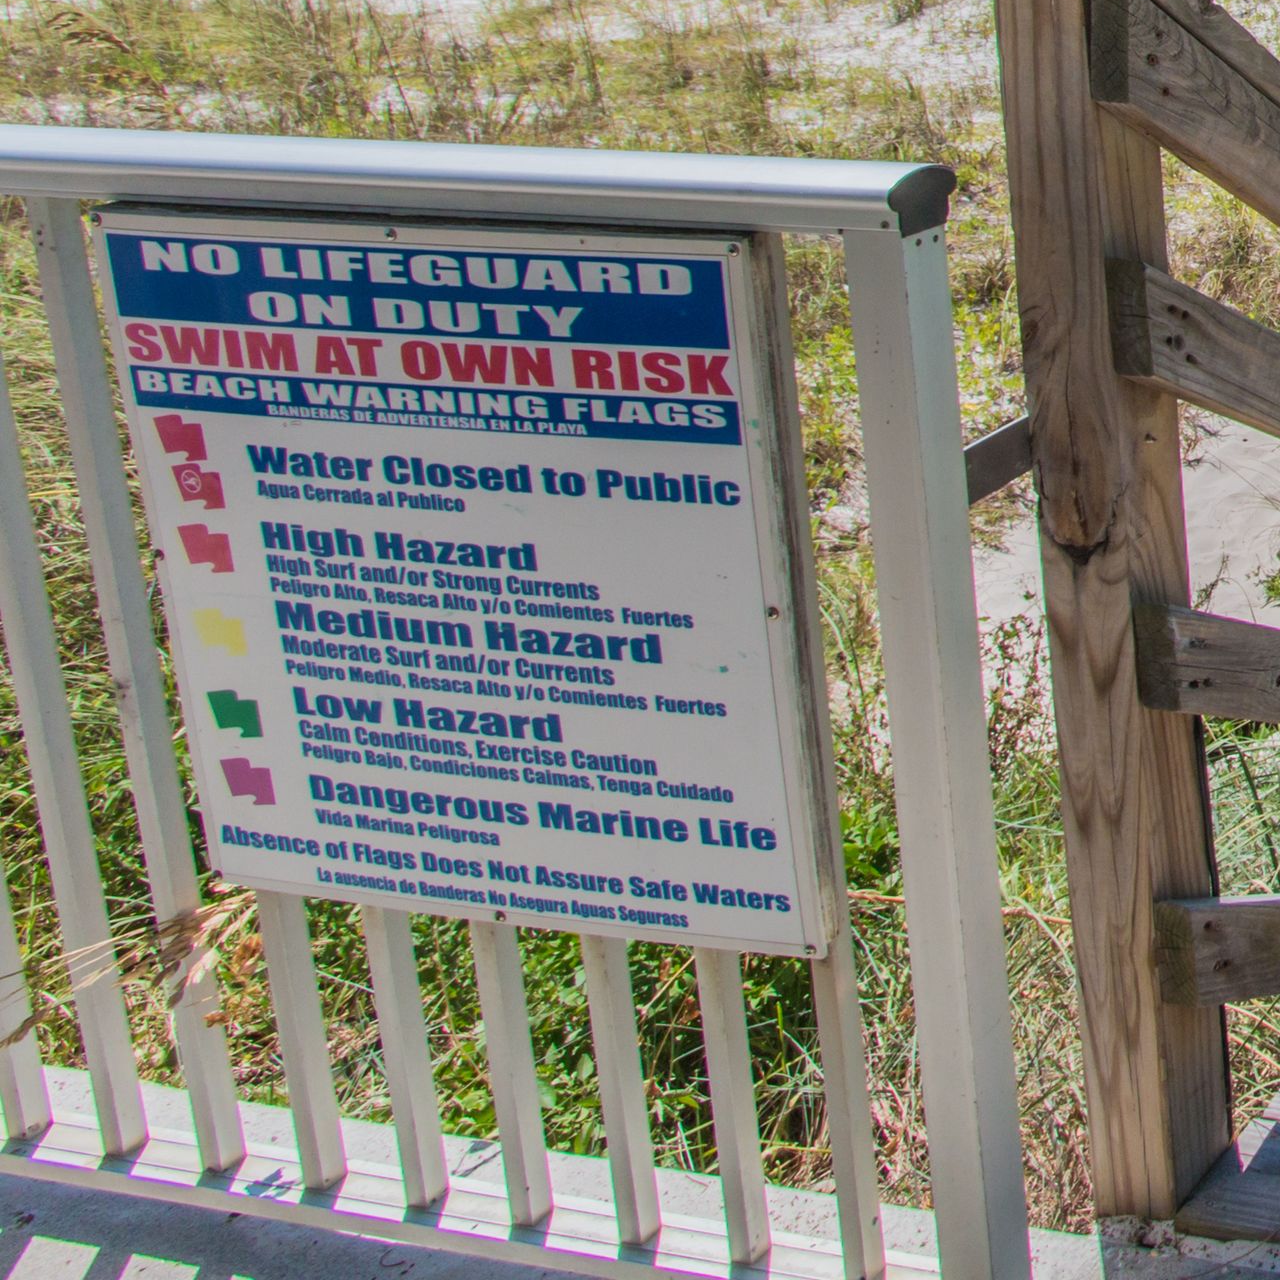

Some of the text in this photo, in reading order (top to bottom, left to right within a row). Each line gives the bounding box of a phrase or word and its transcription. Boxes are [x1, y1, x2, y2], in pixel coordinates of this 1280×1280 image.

[139, 240, 692, 296] NO LIFEGUARD
[247, 291, 582, 338] ON DUTY
[125, 322, 734, 396] SWIM AT OWN RISK
[135, 369, 726, 429] BEACH WARNING FLAGS
[265, 403, 588, 436] BANDERAS DE ADVERTENSIA EN LA PLAYA
[246, 444, 741, 506] Water Closed to Public
[257, 479, 466, 513] Agua Cerrada al Publico
[260, 521, 538, 572] High Hazard
[265, 553, 600, 601] High Surf and/or Strong Currents
[269, 576, 331, 599] Peligro
[333, 583, 372, 604] Alto,
[373, 586, 440, 609] Resaca
[442, 593, 478, 612] Alto
[480, 596, 512, 615] y/o
[621, 607, 694, 629] Fuertes
[274, 599, 663, 665] Medium Hazard
[281, 634, 615, 686] Moderate Surf and/or Currents
[285, 658, 346, 681] Peligro
[348, 665, 406, 689] Medio,
[407, 672, 474, 695] Resaca
[476, 679, 512, 698] Alto
[514, 683, 545, 702] y/o
[654, 694, 727, 718] Fuertes
[292, 686, 563, 743] Low Hazard
[298, 719, 658, 777] Calm Conditions, Exercise Caution
[301, 741, 362, 765] Peligro
[364, 749, 408, 771] Bajo,
[409, 754, 520, 783] Condiciones
[596, 774, 653, 797] Tenga
[656, 780, 734, 804] Cuidado
[308, 774, 777, 851] Dangerous Marine Life
[314, 808, 501, 847] Vida Marina Peligrosa
[221, 824, 791, 913] Absence of Flags Does Not Assure Safe Waters
[316, 866, 689, 928] La ausencia de Banderas No Asegura Aguas Segurass
